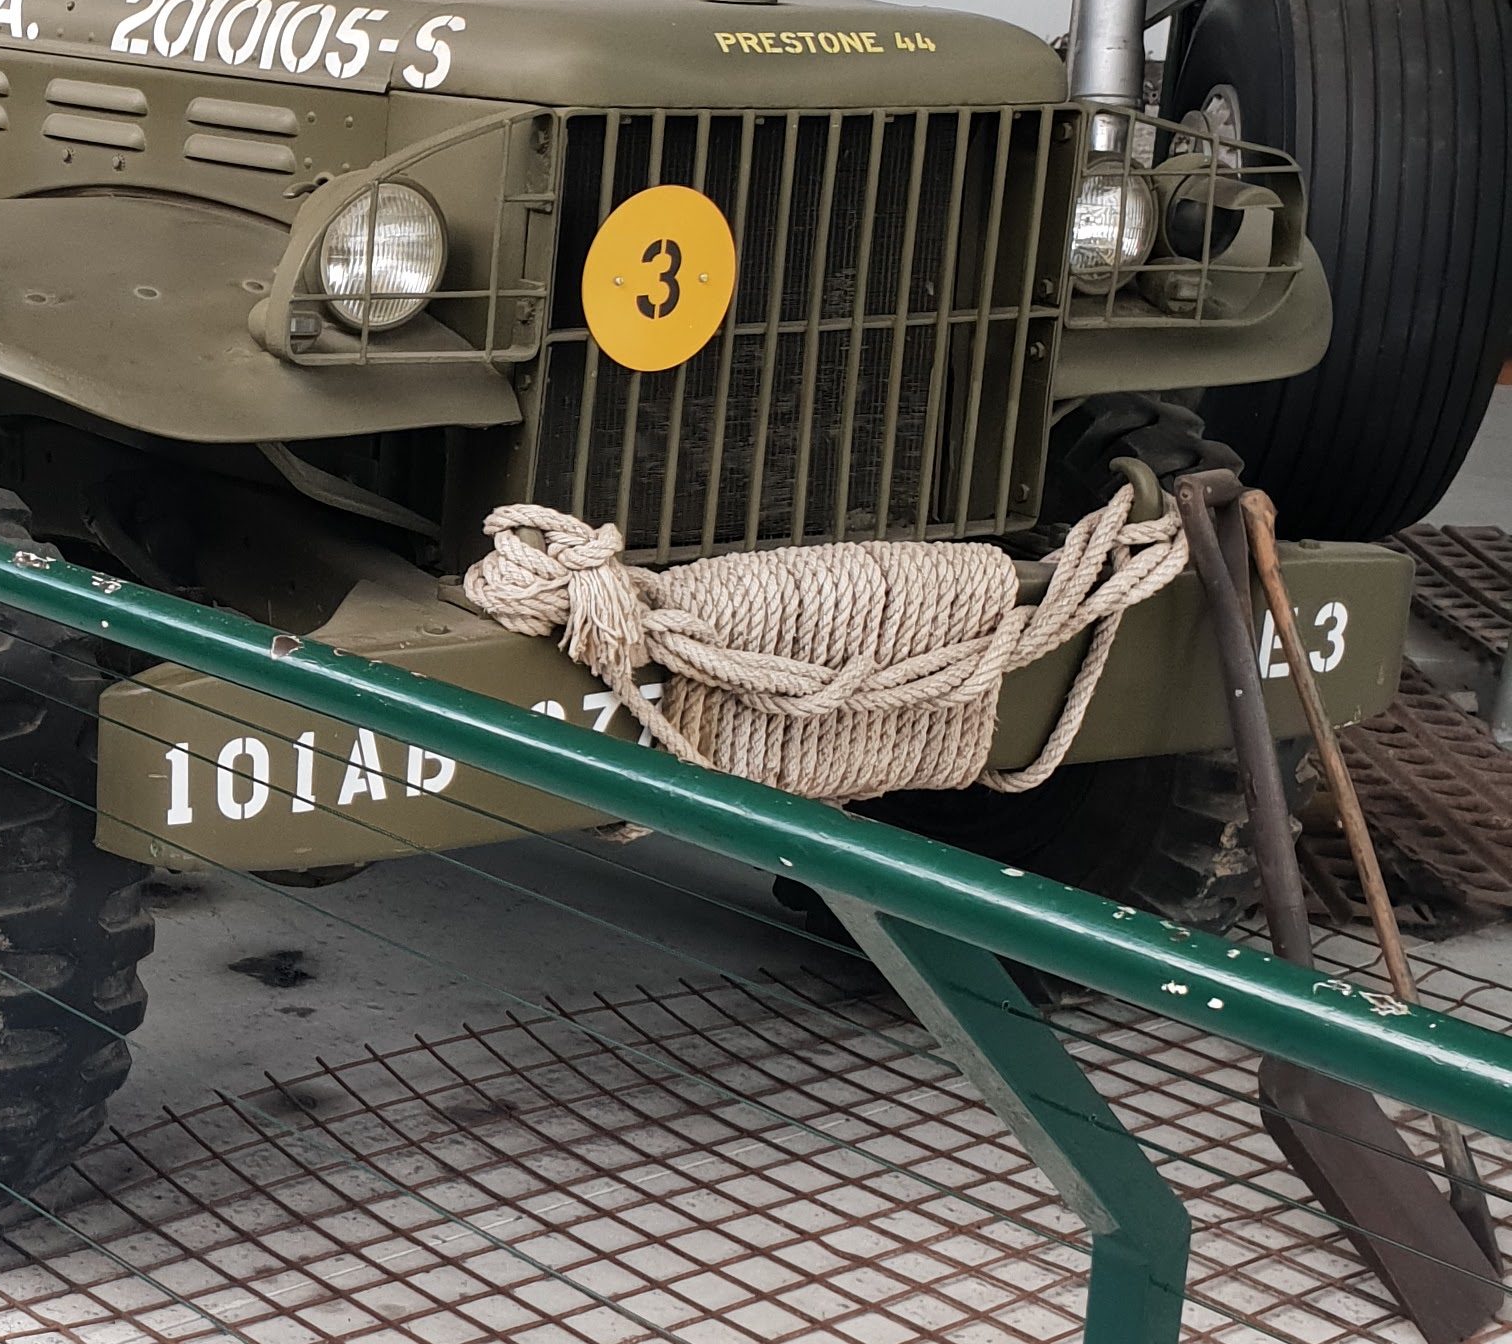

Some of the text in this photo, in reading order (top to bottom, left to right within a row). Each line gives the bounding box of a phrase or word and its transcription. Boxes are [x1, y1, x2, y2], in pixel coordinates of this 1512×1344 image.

[714, 31, 937, 54] PRESTONE 44
[636, 238, 683, 320] 3
